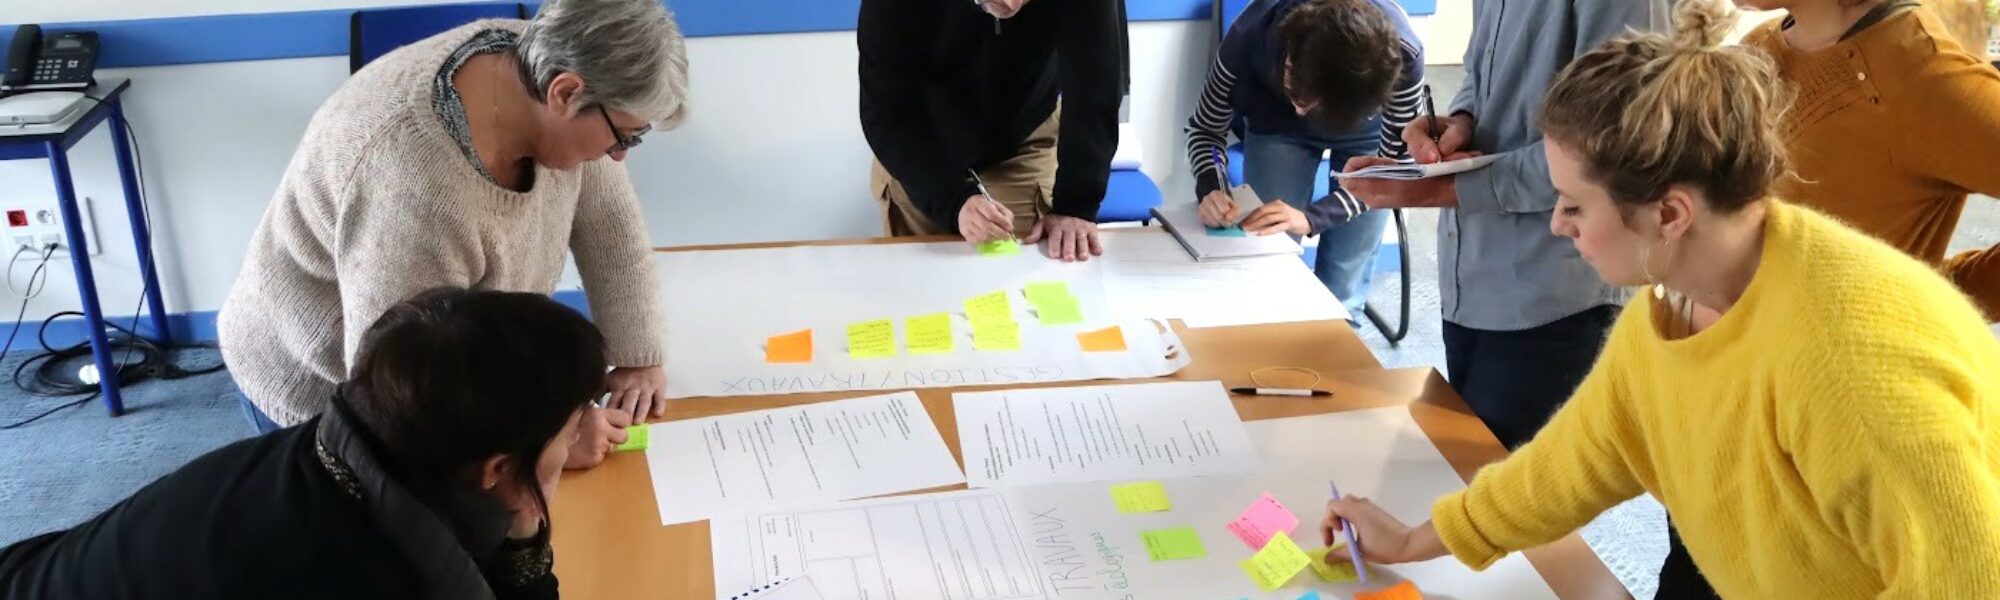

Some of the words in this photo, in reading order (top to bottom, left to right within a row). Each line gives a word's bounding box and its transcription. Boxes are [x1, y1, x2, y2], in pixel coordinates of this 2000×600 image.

[720, 371, 867, 392] TRAVAUX
[903, 365, 1064, 386] GESTION
[1028, 506, 1093, 596] TRAVAUX
